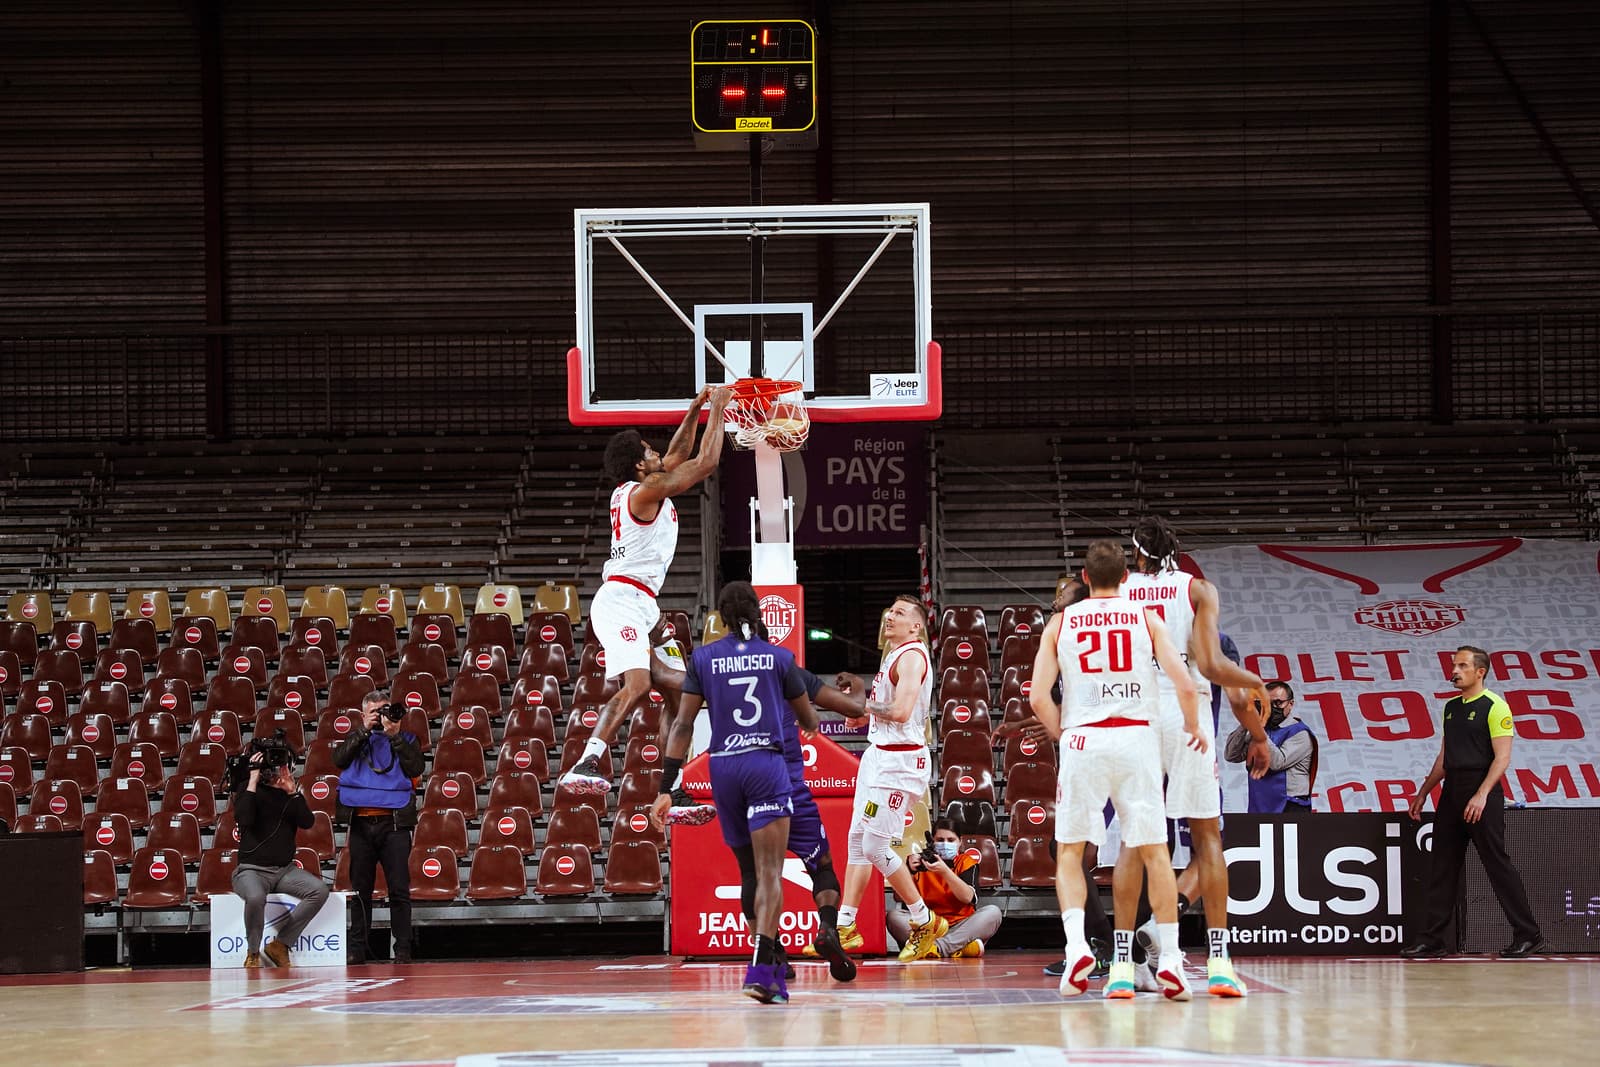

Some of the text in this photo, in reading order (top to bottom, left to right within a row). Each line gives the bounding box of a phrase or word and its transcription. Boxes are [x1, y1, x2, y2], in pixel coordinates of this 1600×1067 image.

[737, 118, 770, 129] Bodet
[893, 378, 919, 389] Jeep
[895, 389, 917, 397] ELITE
[854, 438, 905, 455] Région
[826, 456, 906, 485] PAYS
[871, 487, 906, 500] de la
[816, 504, 907, 533] LOIRE
[1129, 585, 1177, 601] HORTON
[1069, 612, 1139, 630] STOCKTON
[1354, 608, 1468, 624] CHOLET
[1076, 629, 1133, 674] 20
[711, 653, 775, 675] FRANCISCO
[1101, 682, 1142, 700] AGIR
[728, 676, 762, 727] 3
[820, 723, 832, 734] LA
[723, 733, 772, 753] Pierre
[1068, 734, 1086, 751] 20
[916, 757, 926, 770] 15
[889, 794, 903, 809] CB
[1226, 822, 1403, 916] dlsi
[1300, 925, 1350, 944] CDD
[1363, 925, 1404, 944] CDI
